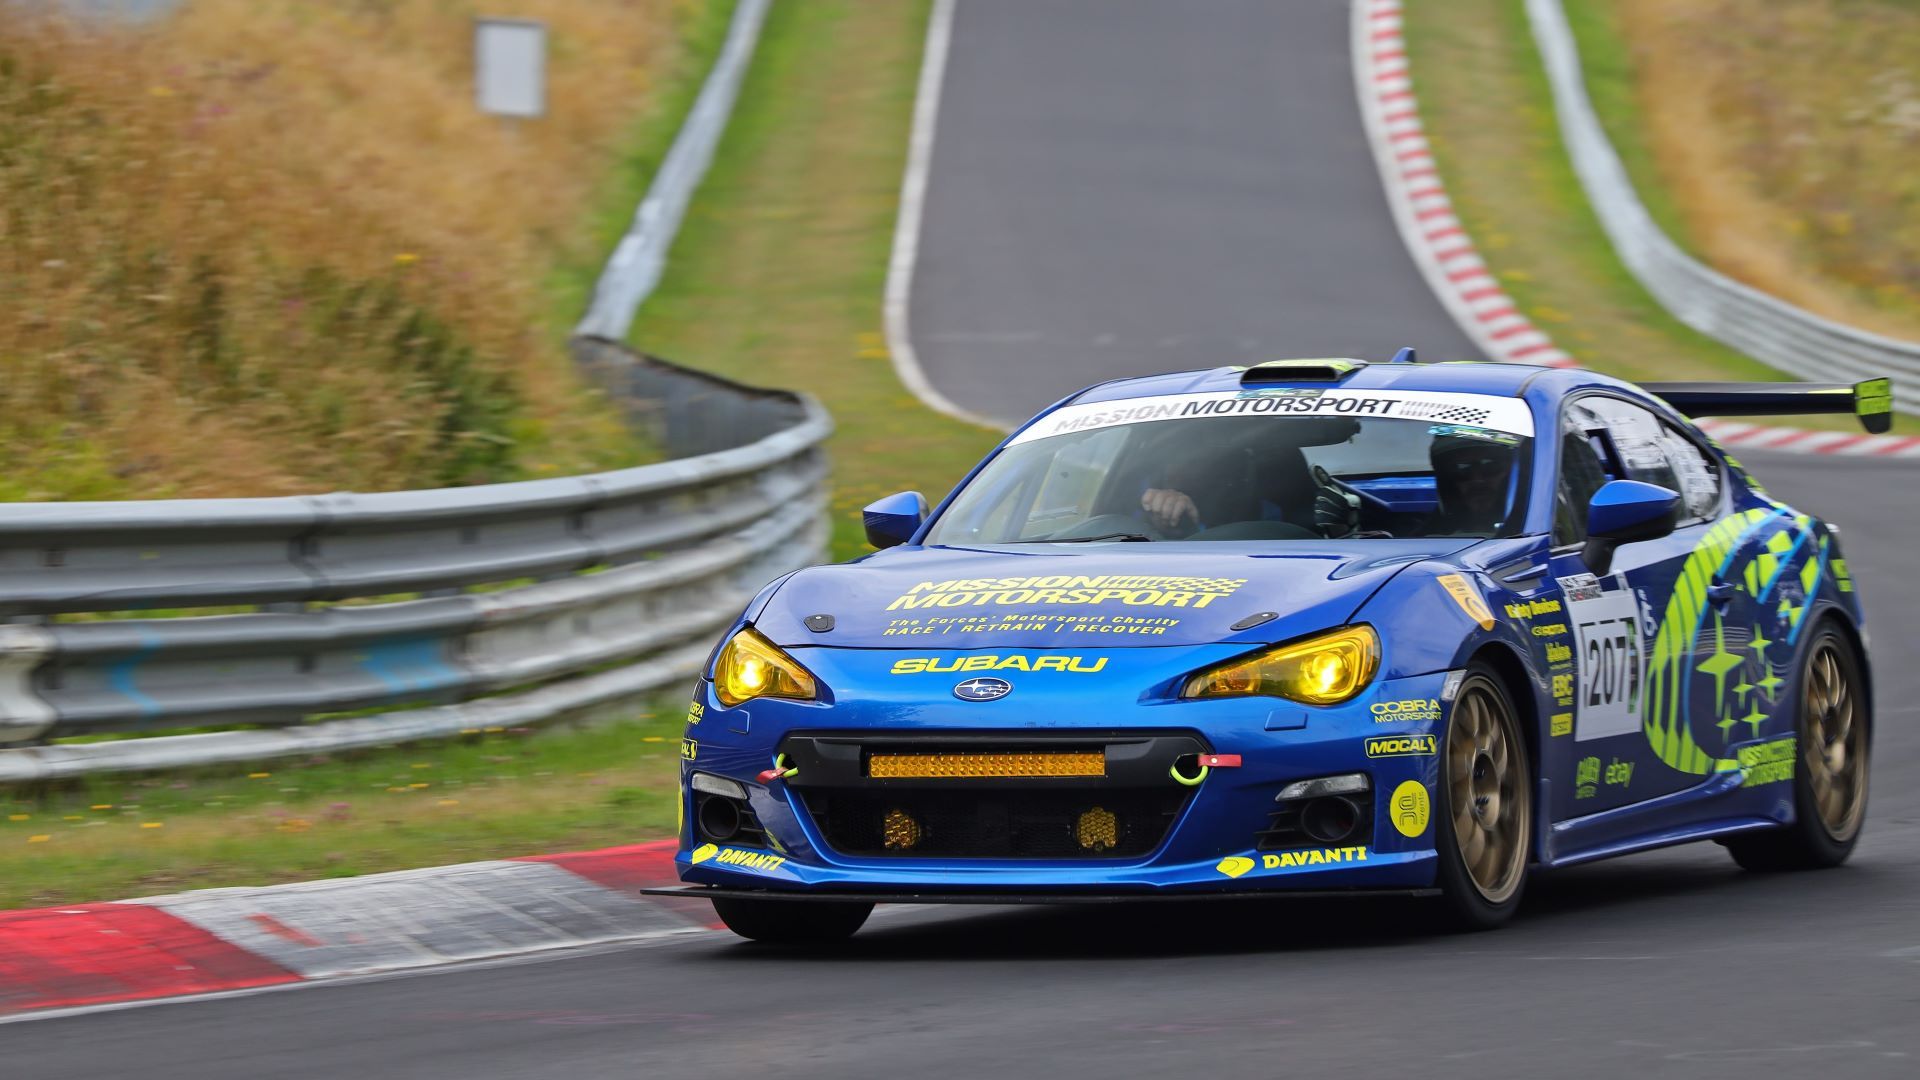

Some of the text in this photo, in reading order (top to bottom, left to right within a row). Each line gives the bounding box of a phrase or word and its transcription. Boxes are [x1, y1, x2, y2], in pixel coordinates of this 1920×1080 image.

[1054, 396, 1402, 432] MISSION MOTORSPORT
[906, 575, 1110, 595] MISSION
[886, 588, 1231, 611] MOTORSPORT
[883, 626, 935, 636] RACE
[960, 623, 1046, 633] RETRAIN
[1073, 624, 1166, 635] RECOVER
[889, 618, 920, 627] The
[1003, 614, 1105, 623] Motorsport
[1112, 616, 1180, 627] Charity
[890, 655, 1109, 674] SUBARU
[1588, 636, 1627, 706] 207
[1370, 699, 1441, 715] COBRA
[1374, 711, 1443, 723] MOTORSPORT
[1369, 738, 1427, 755] MOCAL
[715, 848, 785, 871] DAVANTI
[1262, 846, 1367, 869] DAVANTI
